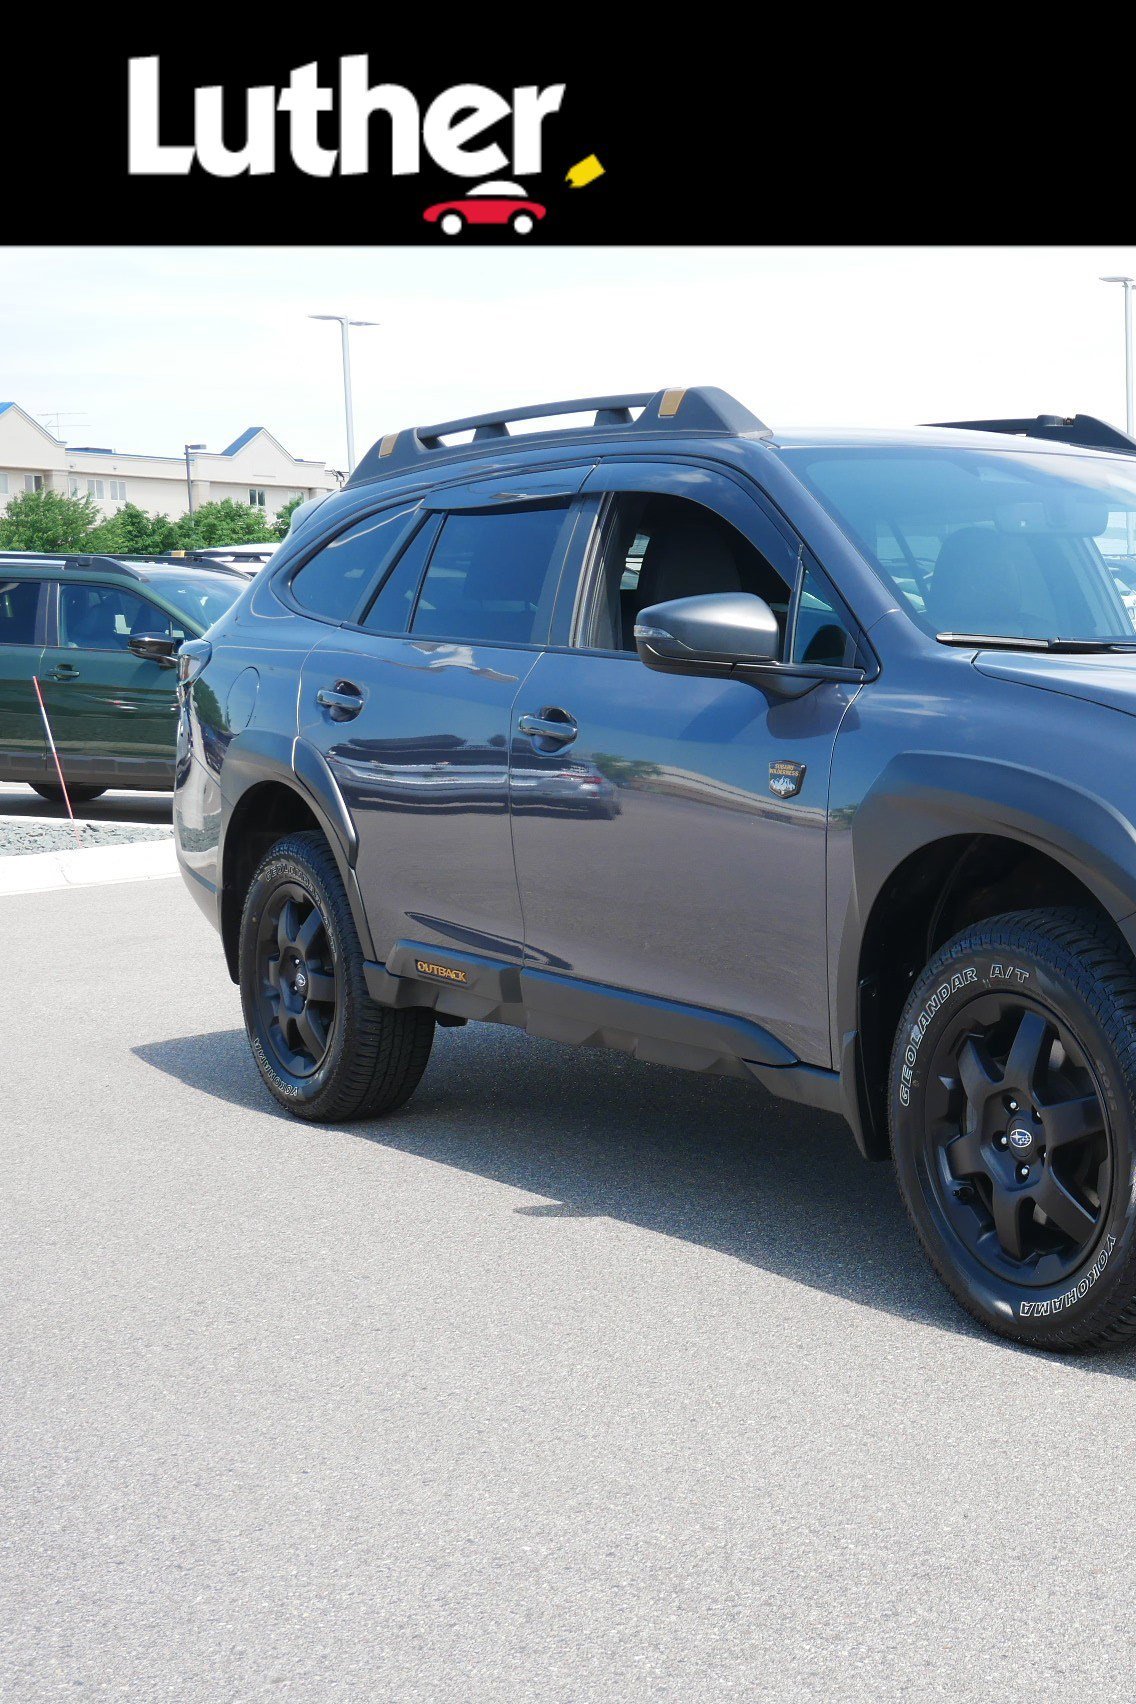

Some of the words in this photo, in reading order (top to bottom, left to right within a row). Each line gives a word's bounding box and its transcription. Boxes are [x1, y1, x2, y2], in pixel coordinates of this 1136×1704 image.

[417, 961, 467, 983] OUTBACK
[899, 967, 978, 1107] GEOLANDAR
[989, 964, 1030, 983] A/T
[1019, 1233, 1117, 1317] YOKOHAMA
